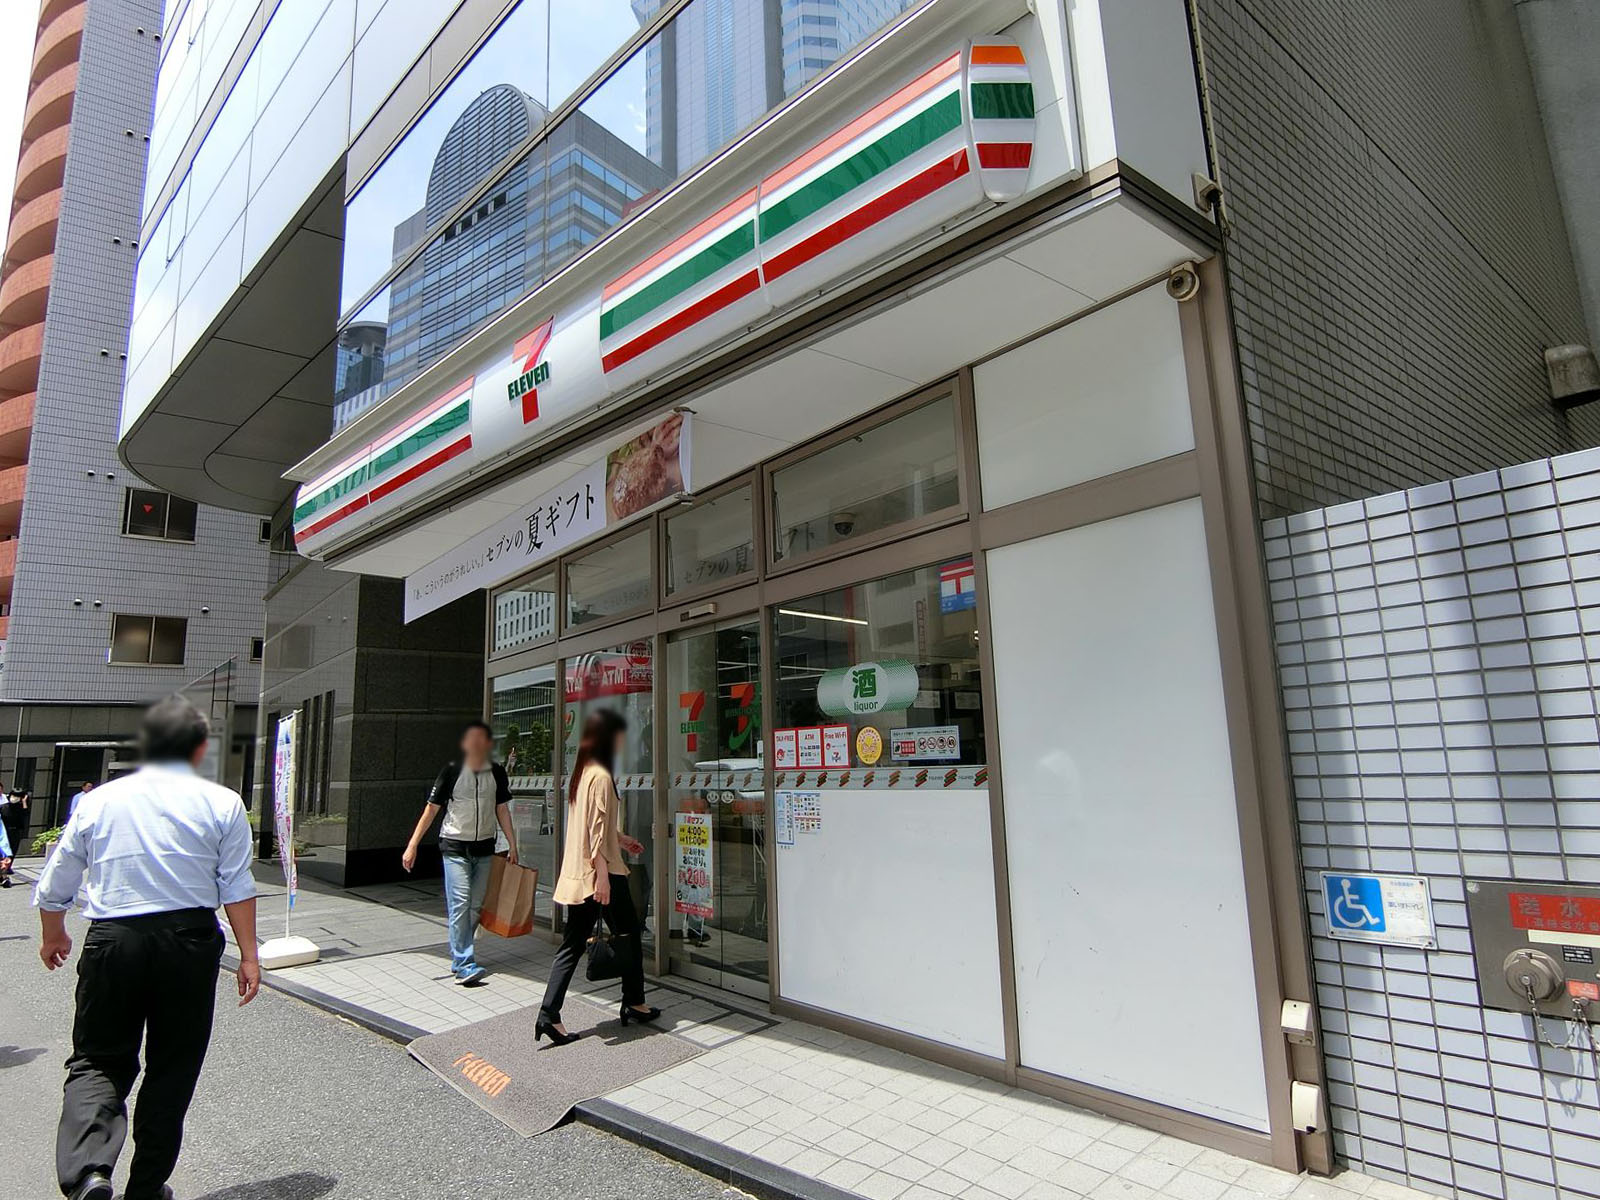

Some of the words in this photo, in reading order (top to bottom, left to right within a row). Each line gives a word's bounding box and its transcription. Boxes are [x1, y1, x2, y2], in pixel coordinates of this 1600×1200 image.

[512, 314, 554, 425] 7
[486, 484, 594, 562] セブンの夏ギフト
[602, 668, 624, 687] ATM
[852, 667, 877, 698] 酒
[853, 701, 879, 711] liquor
